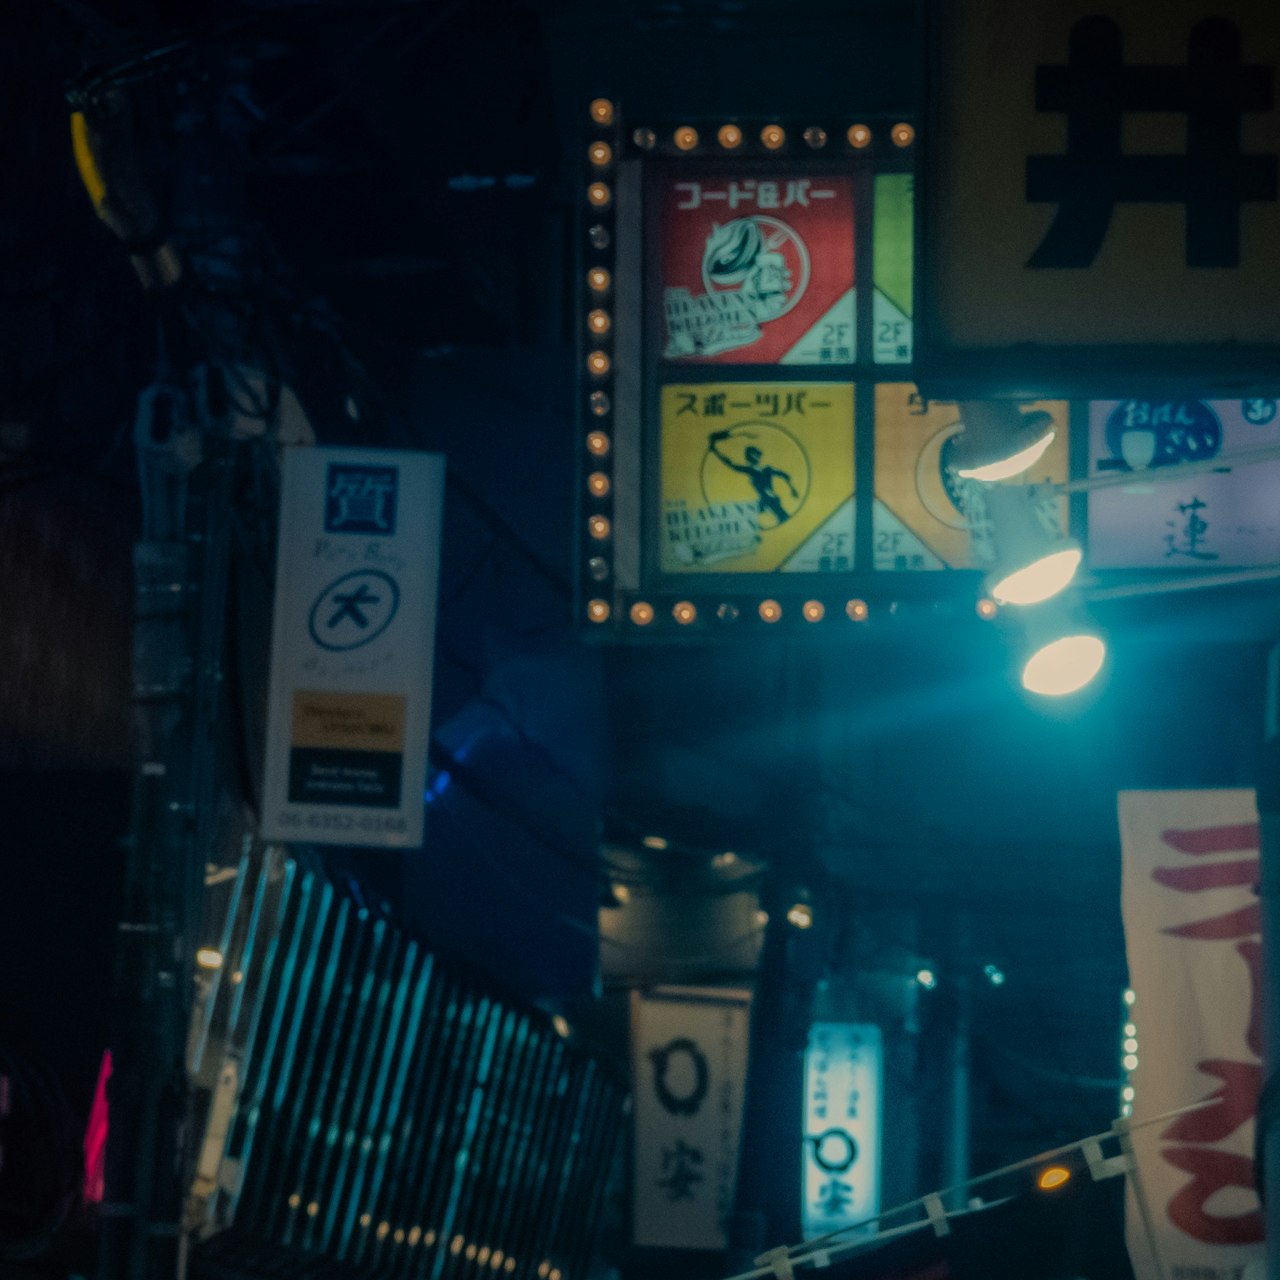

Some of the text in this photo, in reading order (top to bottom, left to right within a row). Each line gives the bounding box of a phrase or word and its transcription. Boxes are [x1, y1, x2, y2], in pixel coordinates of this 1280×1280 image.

[1026, 13, 1277, 268] 井
[676, 391, 831, 418] スポーツバー
[329, 472, 395, 530] 質
[1162, 497, 1219, 560] 蓮
